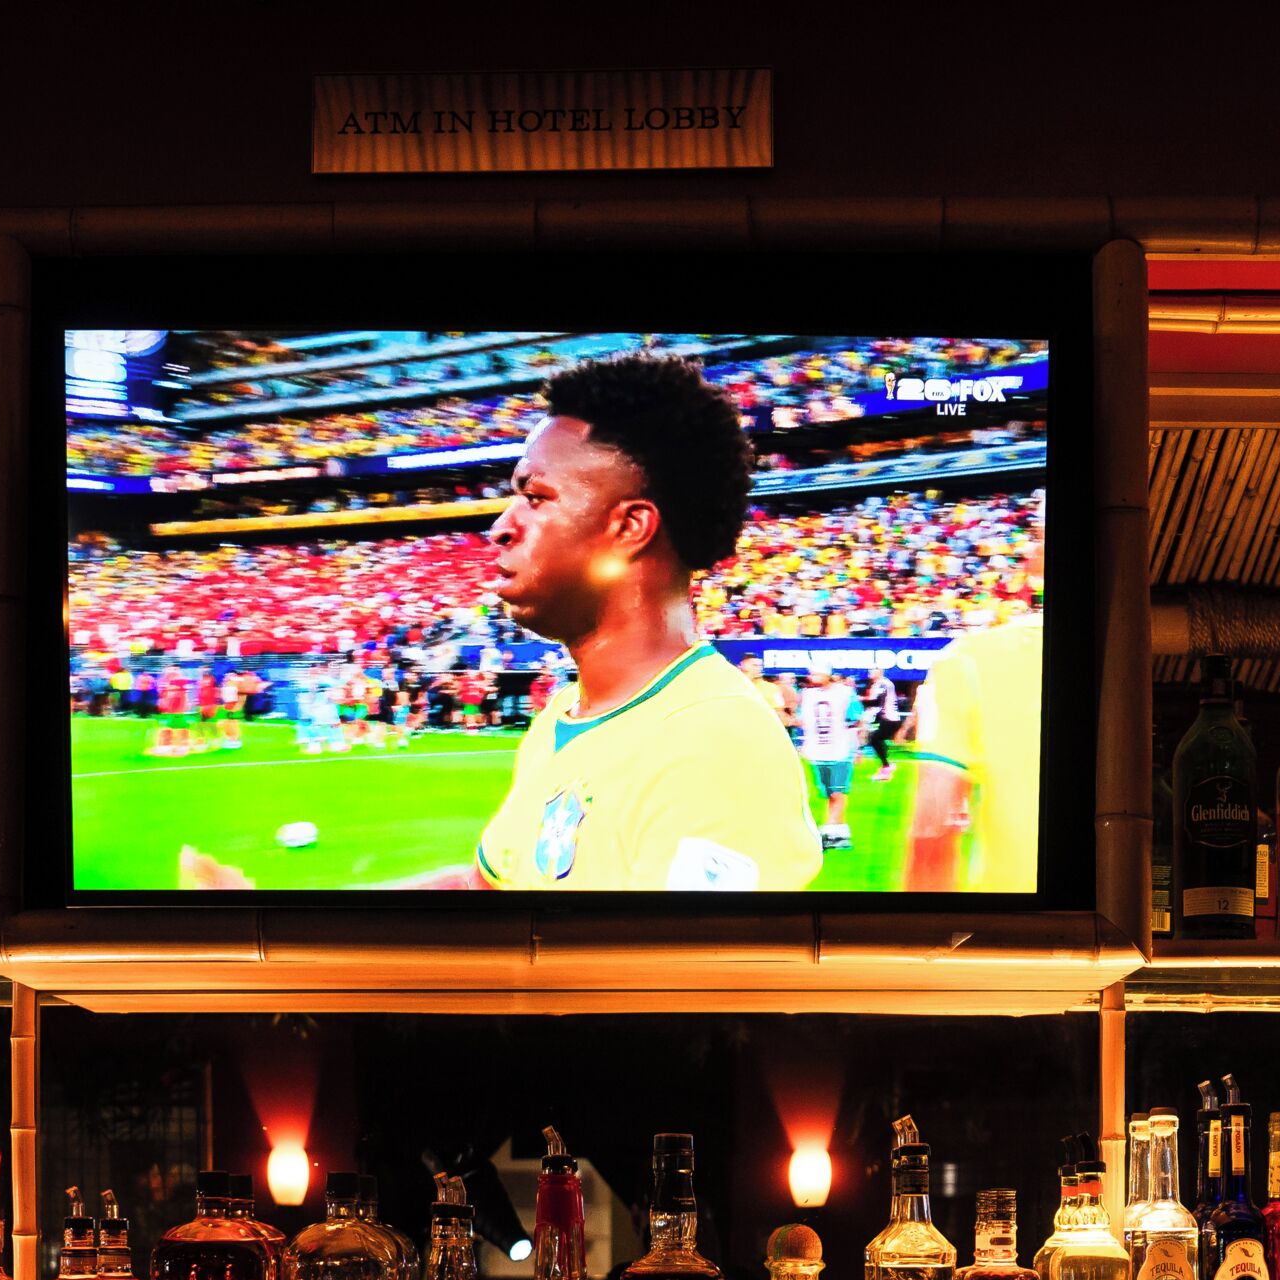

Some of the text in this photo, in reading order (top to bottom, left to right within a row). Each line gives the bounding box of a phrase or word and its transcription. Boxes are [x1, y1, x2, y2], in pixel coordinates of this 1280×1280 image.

[337, 105, 747, 135] ATM IN HOTEL LOBBY
[936, 403, 967, 416] LIVE
[1191, 803, 1251, 823] Glenfiddich
[1216, 899, 1230, 911] 12
[1149, 1261, 1186, 1278] TEQUILA
[1229, 1262, 1263, 1278] TEQUILA
